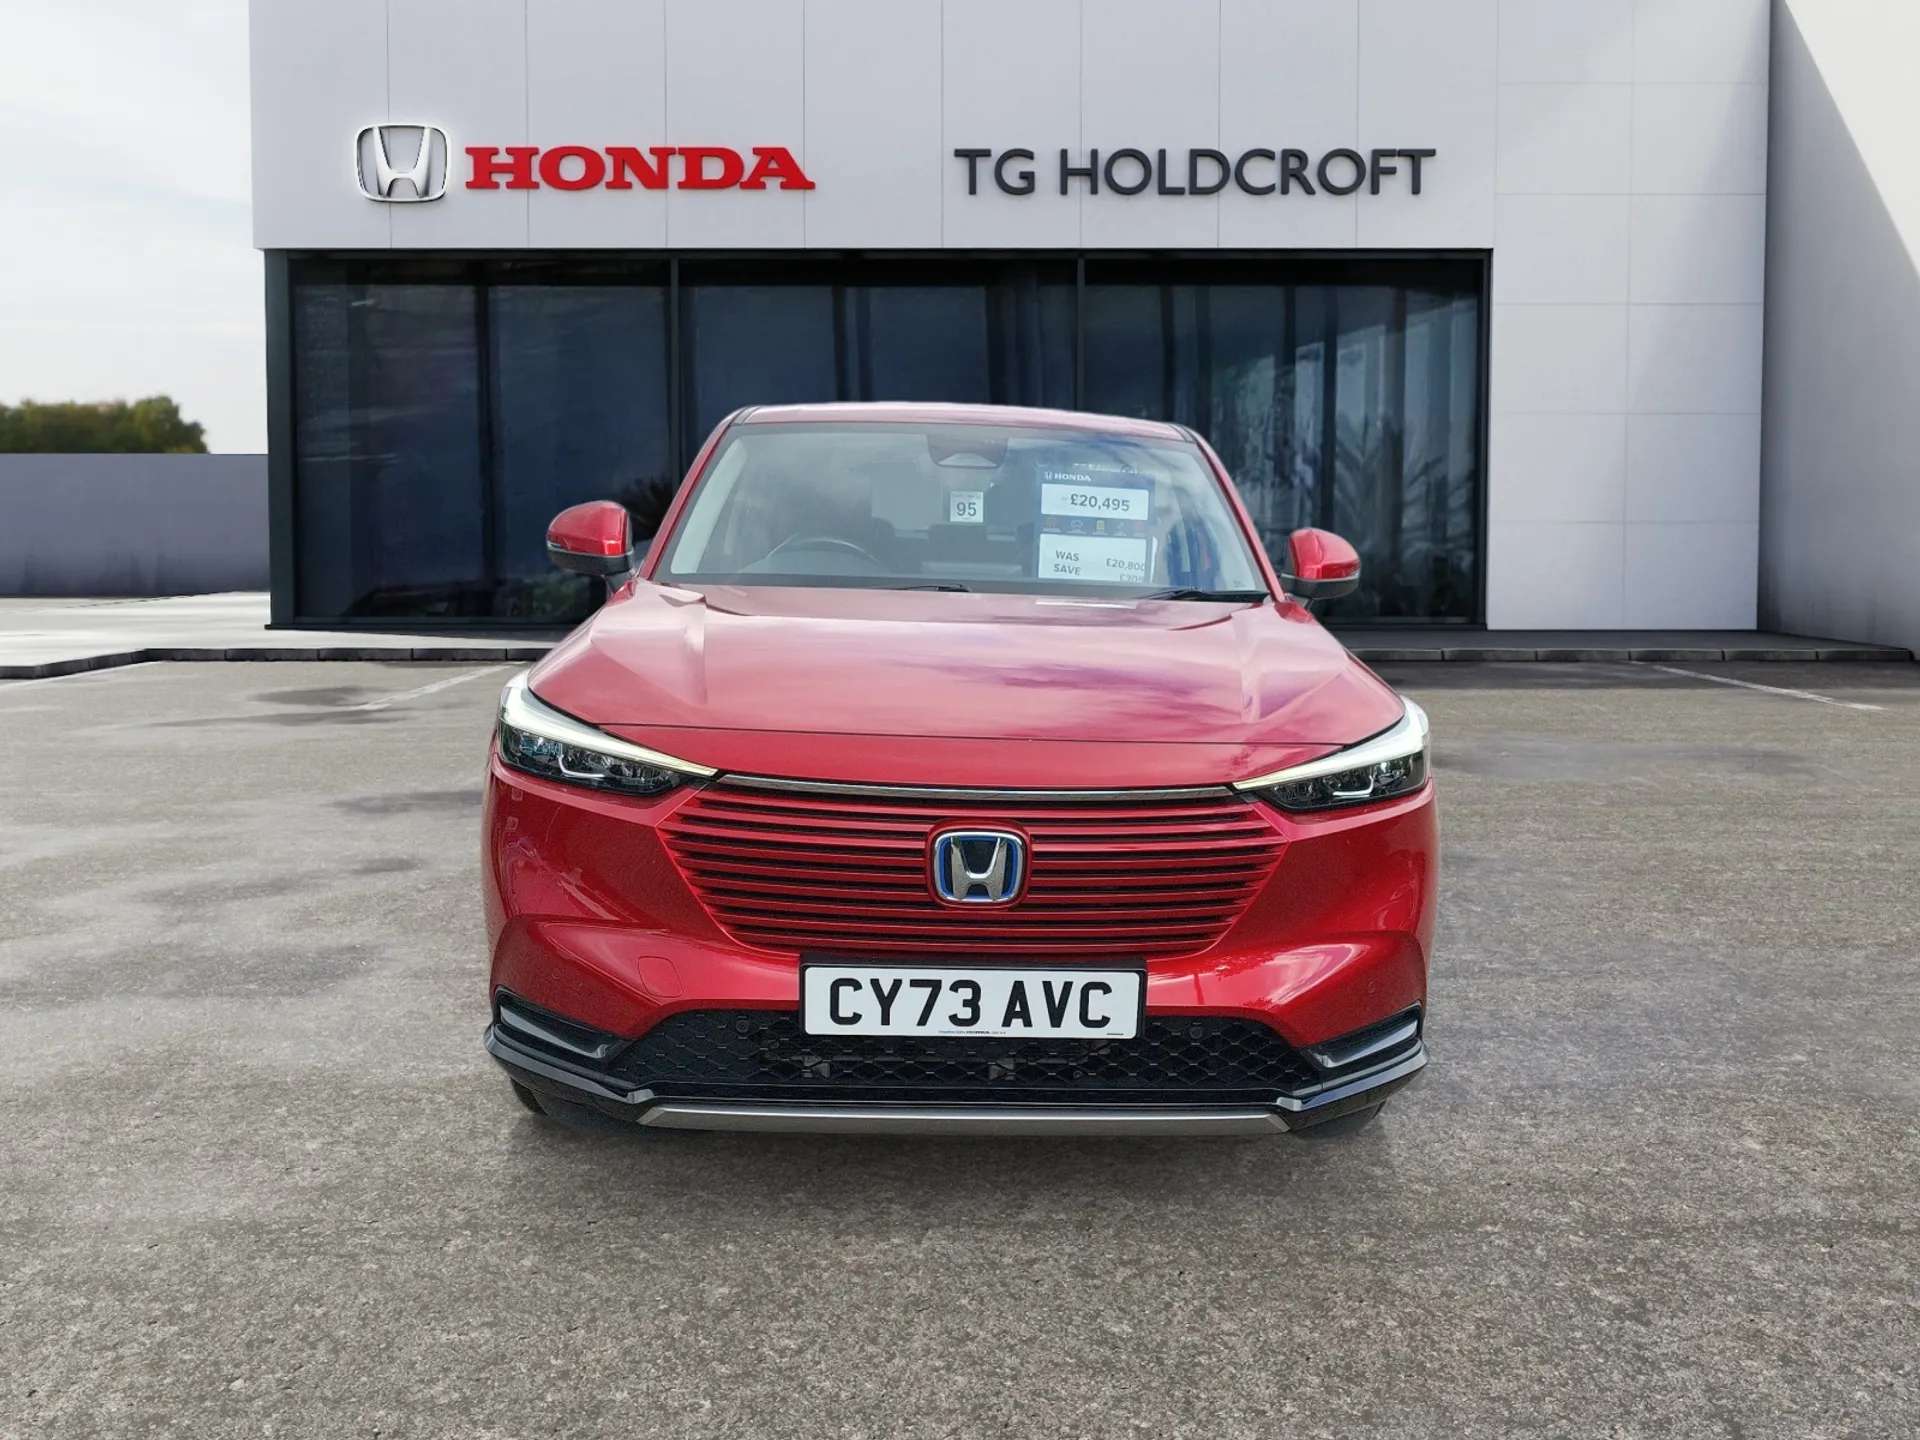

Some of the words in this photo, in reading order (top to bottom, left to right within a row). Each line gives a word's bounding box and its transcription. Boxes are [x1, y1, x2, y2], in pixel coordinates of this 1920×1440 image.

[465, 146, 816, 190] HONDA
[954, 148, 1036, 196] TG
[1060, 148, 1437, 196] HOLDCROFT
[1054, 471, 1092, 482] HONDA
[956, 502, 977, 517] 95
[1070, 493, 1131, 512] £20,495
[1055, 550, 1080, 562] WAS
[1053, 563, 1081, 576] SAVE
[829, 978, 982, 1027] CY73
[1001, 980, 1113, 1029] AVC
